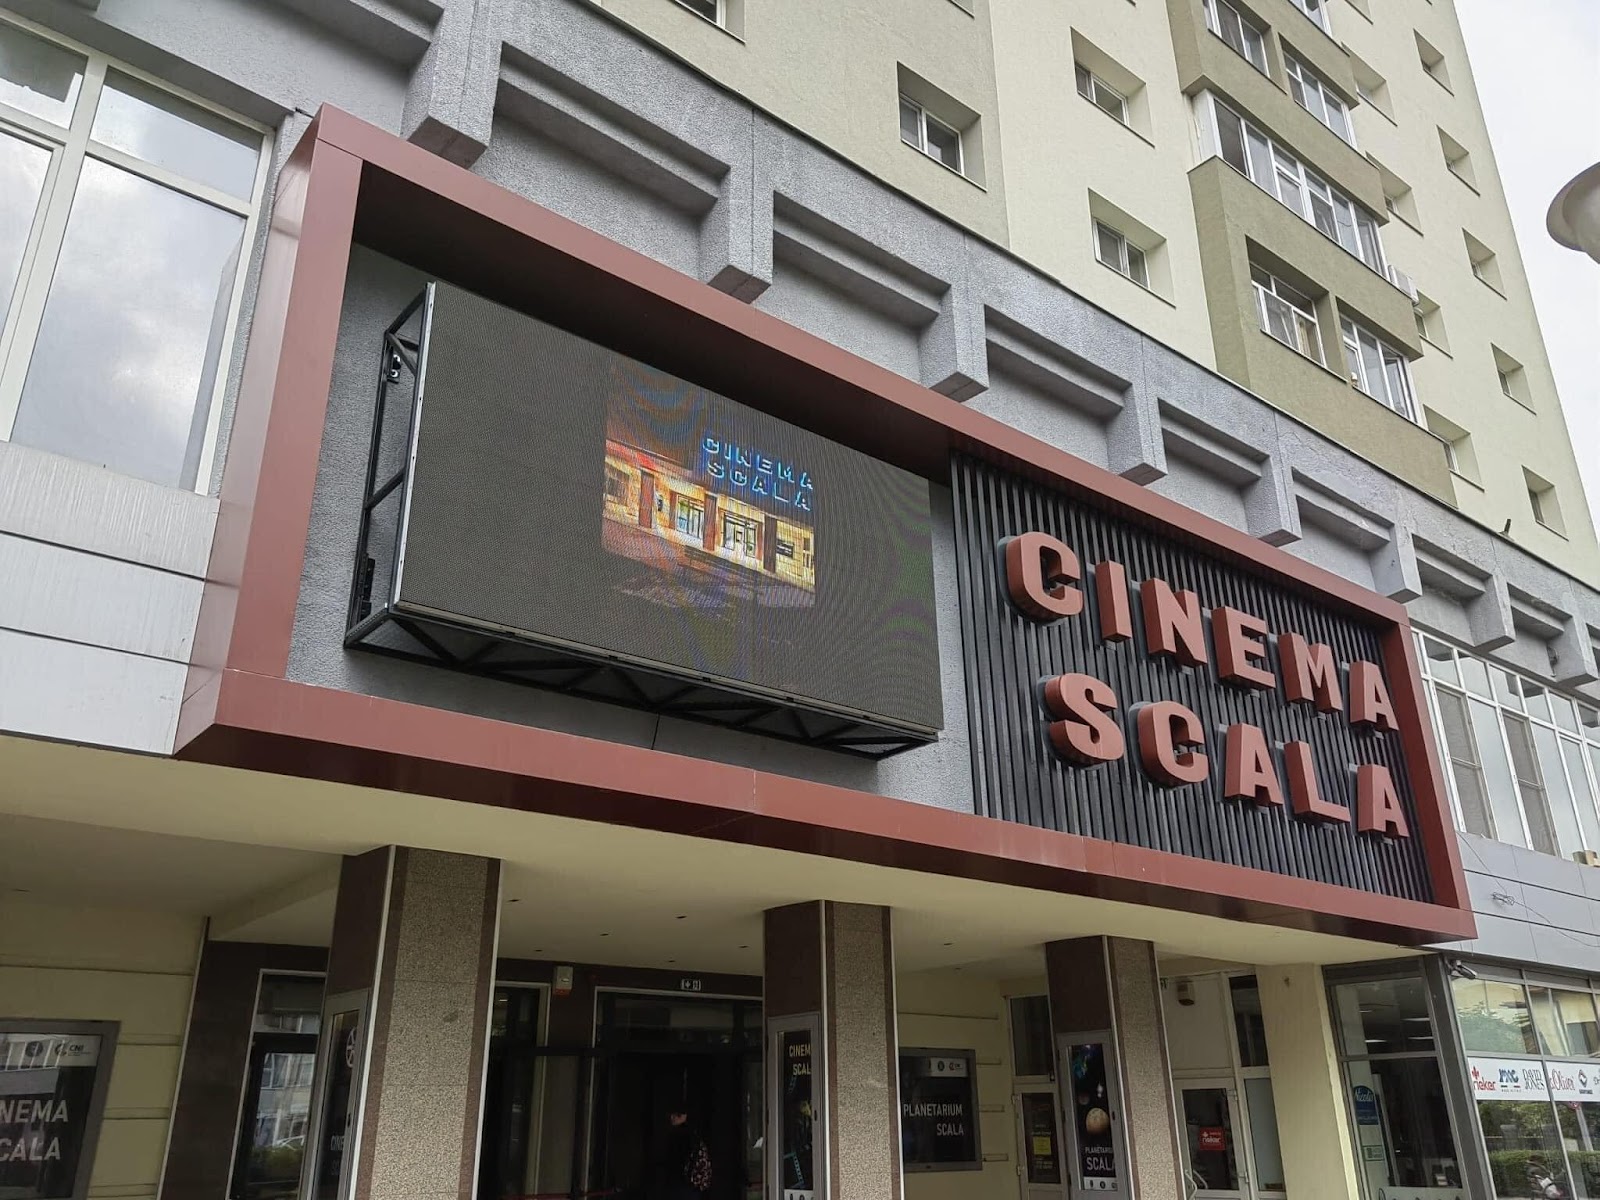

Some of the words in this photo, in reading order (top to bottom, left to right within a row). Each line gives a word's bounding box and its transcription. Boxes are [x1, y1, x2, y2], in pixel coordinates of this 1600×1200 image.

[702, 437, 814, 490] CINEMA
[707, 461, 811, 511] SCALA
[1005, 531, 1399, 732] CINEMA
[1044, 672, 1410, 839] SCALA
[903, 1103, 963, 1117] PLANETARIUM
[936, 1123, 965, 1137] SCALA
